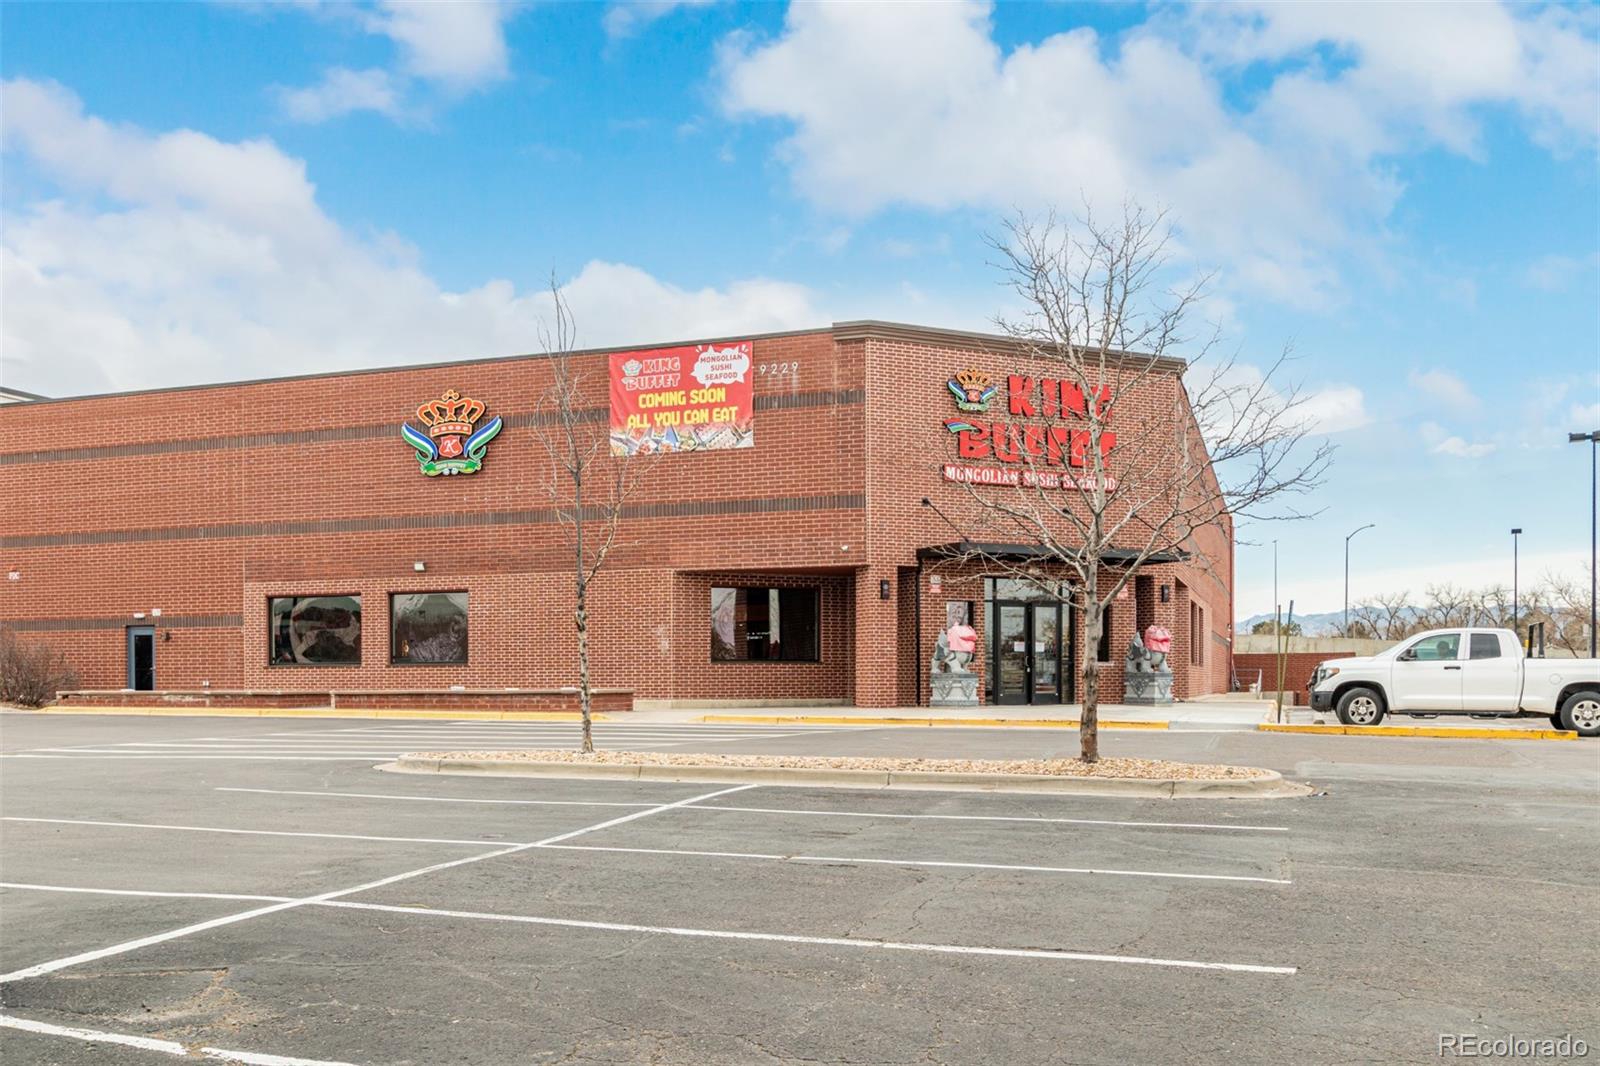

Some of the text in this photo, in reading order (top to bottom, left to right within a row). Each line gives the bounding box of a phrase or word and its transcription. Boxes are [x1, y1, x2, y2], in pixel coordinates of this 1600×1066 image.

[643, 357, 681, 373] KING
[700, 354, 743, 363] MONGOLIAN
[710, 363, 732, 371] SUSHI
[760, 361, 799, 375] 9229
[622, 373, 681, 391] BUFFET
[705, 372, 738, 380] SEAFOOD
[638, 387, 726, 408] COMING SOON
[627, 406, 738, 429] ALL YOU CAN EAT
[444, 440, 459, 453] K
[945, 466, 1019, 484] MONGOLIAN
